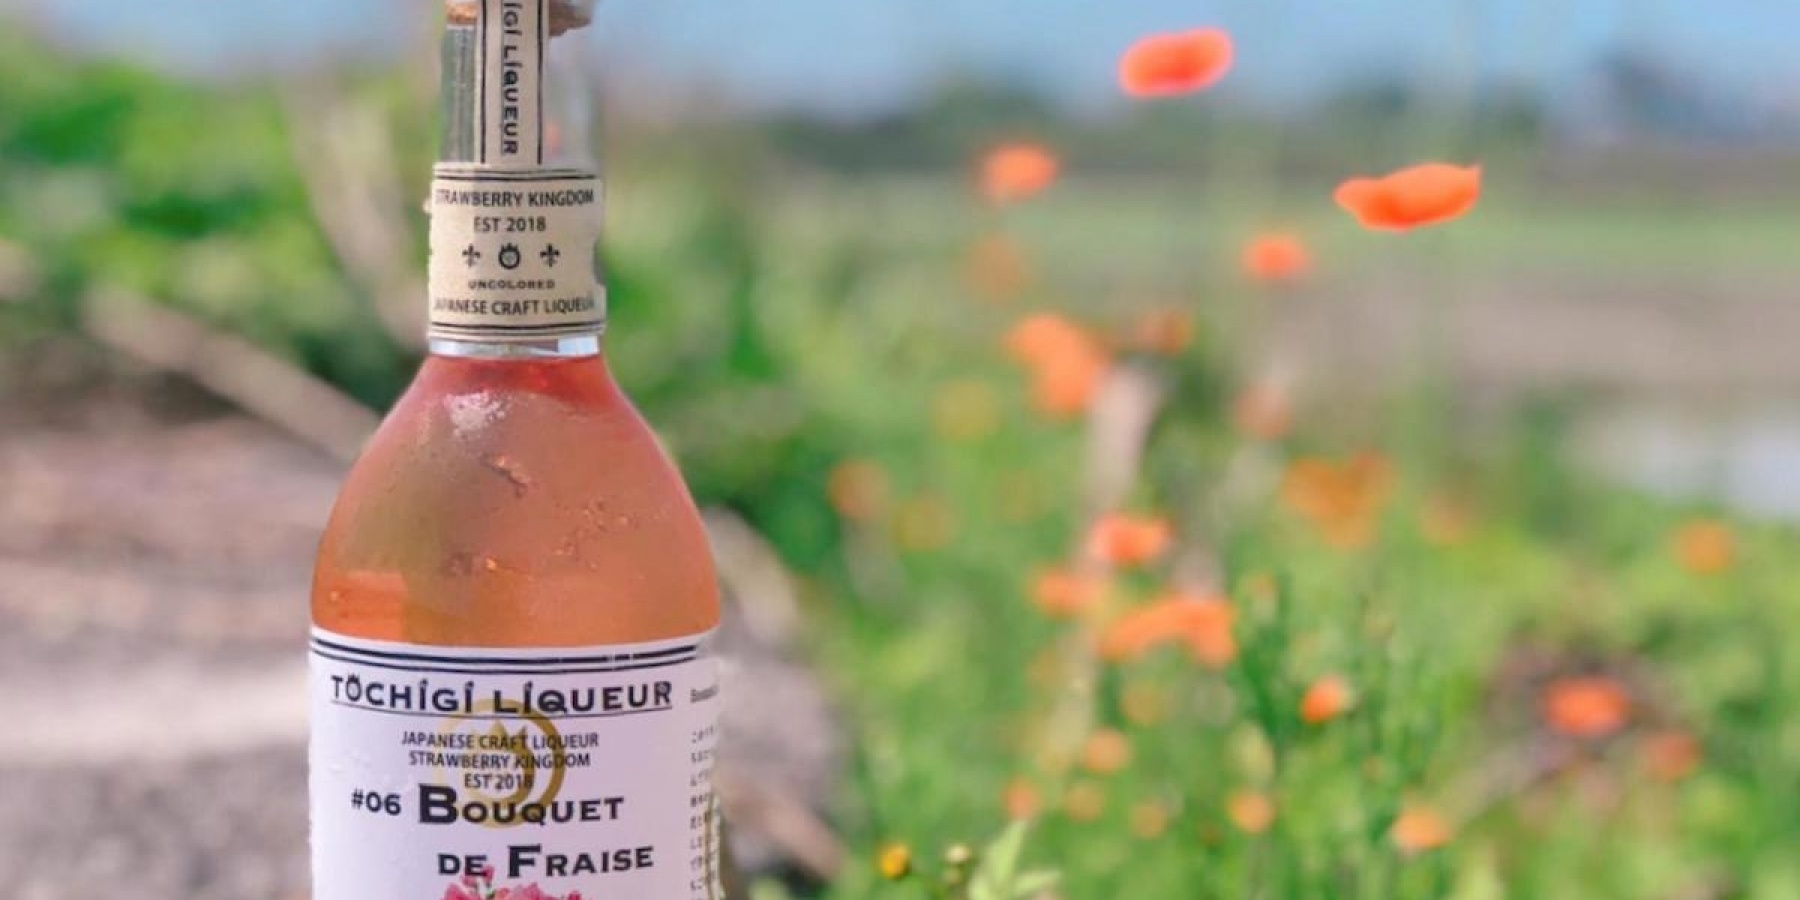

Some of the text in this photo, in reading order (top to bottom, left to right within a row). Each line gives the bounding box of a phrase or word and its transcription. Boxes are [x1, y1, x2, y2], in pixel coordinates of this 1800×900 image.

[435, 188, 595, 208] TRAWBERRY KINGDOM
[473, 216, 547, 232] EST 2018
[467, 278, 556, 290] UNCOLORED
[491, 299, 539, 316] CRAFT
[401, 731, 600, 750] JAPANESE CRAFT LIQUEUR
[408, 751, 591, 769] STRAWBERRY KINGDOM
[464, 773, 533, 790] EST 2018
[350, 788, 401, 816] #06
